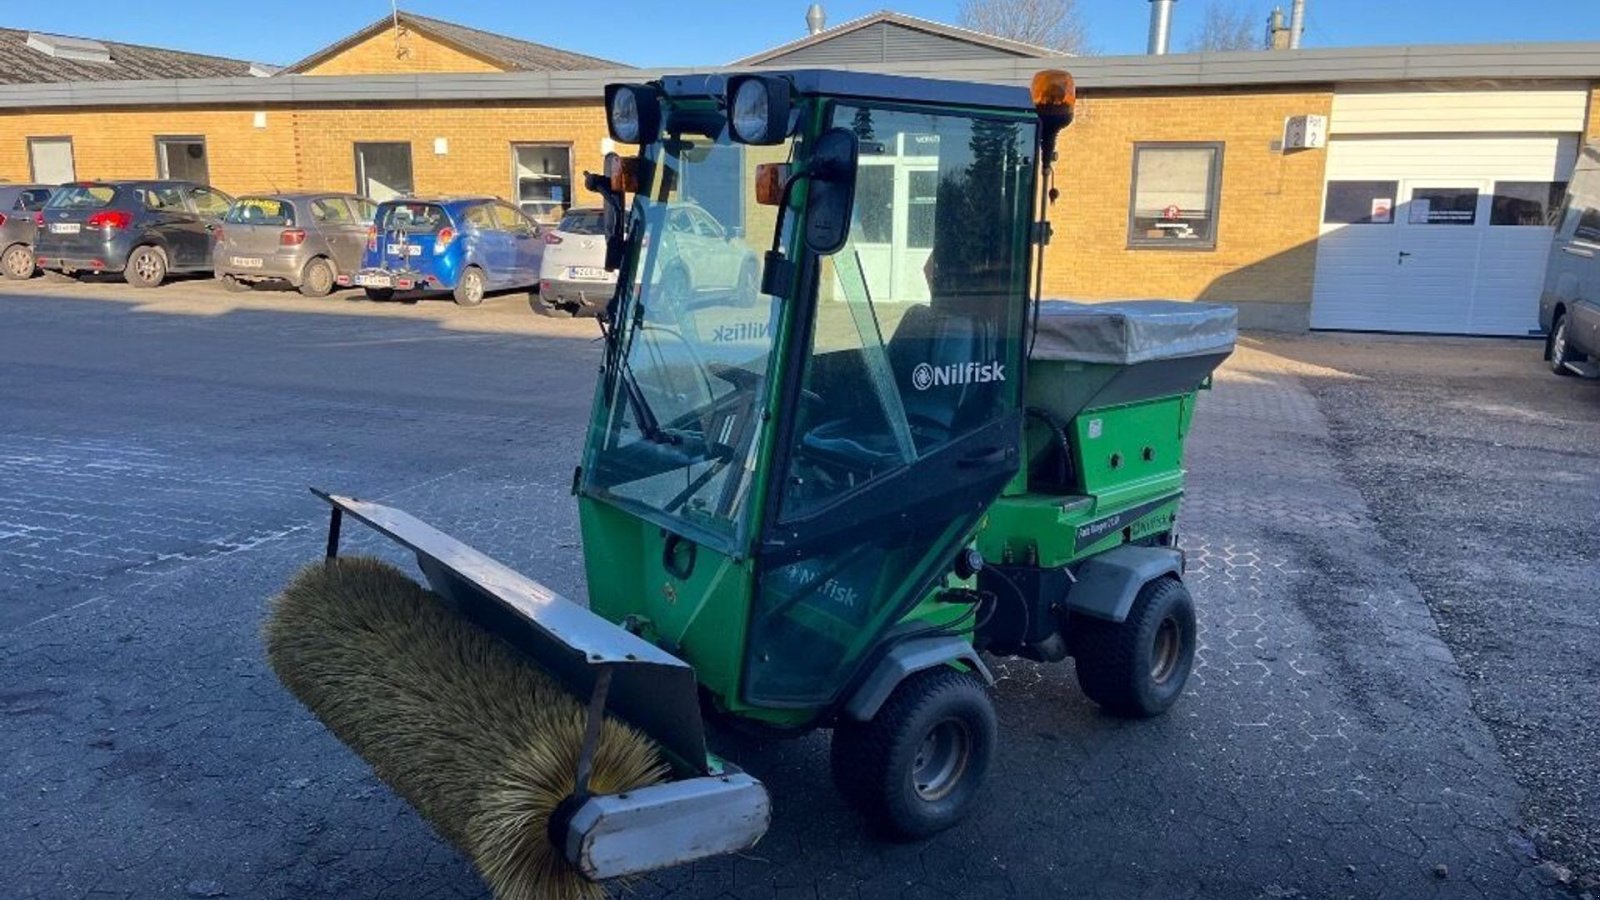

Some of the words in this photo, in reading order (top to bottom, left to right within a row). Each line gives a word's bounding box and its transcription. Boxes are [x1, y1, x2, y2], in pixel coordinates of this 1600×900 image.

[1293, 132, 1302, 146] 2
[1310, 132, 1317, 146] 2
[934, 361, 1006, 386] Nilfisk
[799, 567, 859, 607] Nfisk
